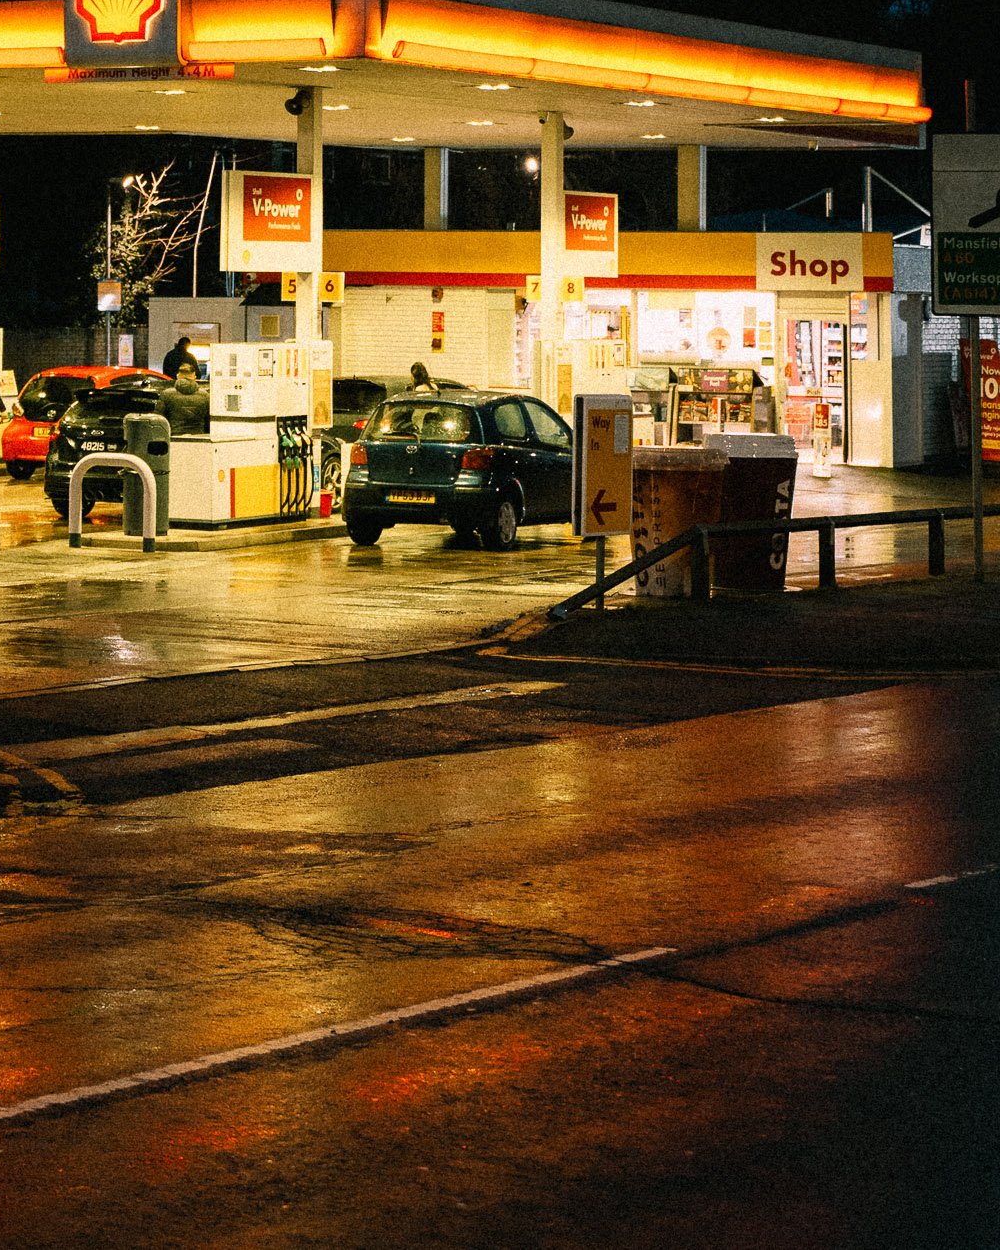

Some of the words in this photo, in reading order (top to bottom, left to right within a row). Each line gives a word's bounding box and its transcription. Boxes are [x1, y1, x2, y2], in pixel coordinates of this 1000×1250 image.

[68, 67, 127, 79] Maximum
[131, 66, 171, 80] Height
[253, 199, 300, 217] V-Power
[572, 214, 607, 230] V-Power
[770, 249, 850, 285] Shop
[287, 279, 296, 294] 5
[325, 279, 334, 293] 6
[531, 282, 539, 293] 7
[567, 282, 575, 293] 8
[591, 415, 611, 432] Way
[590, 438, 600, 451] In
[770, 480, 790, 570] COTA
